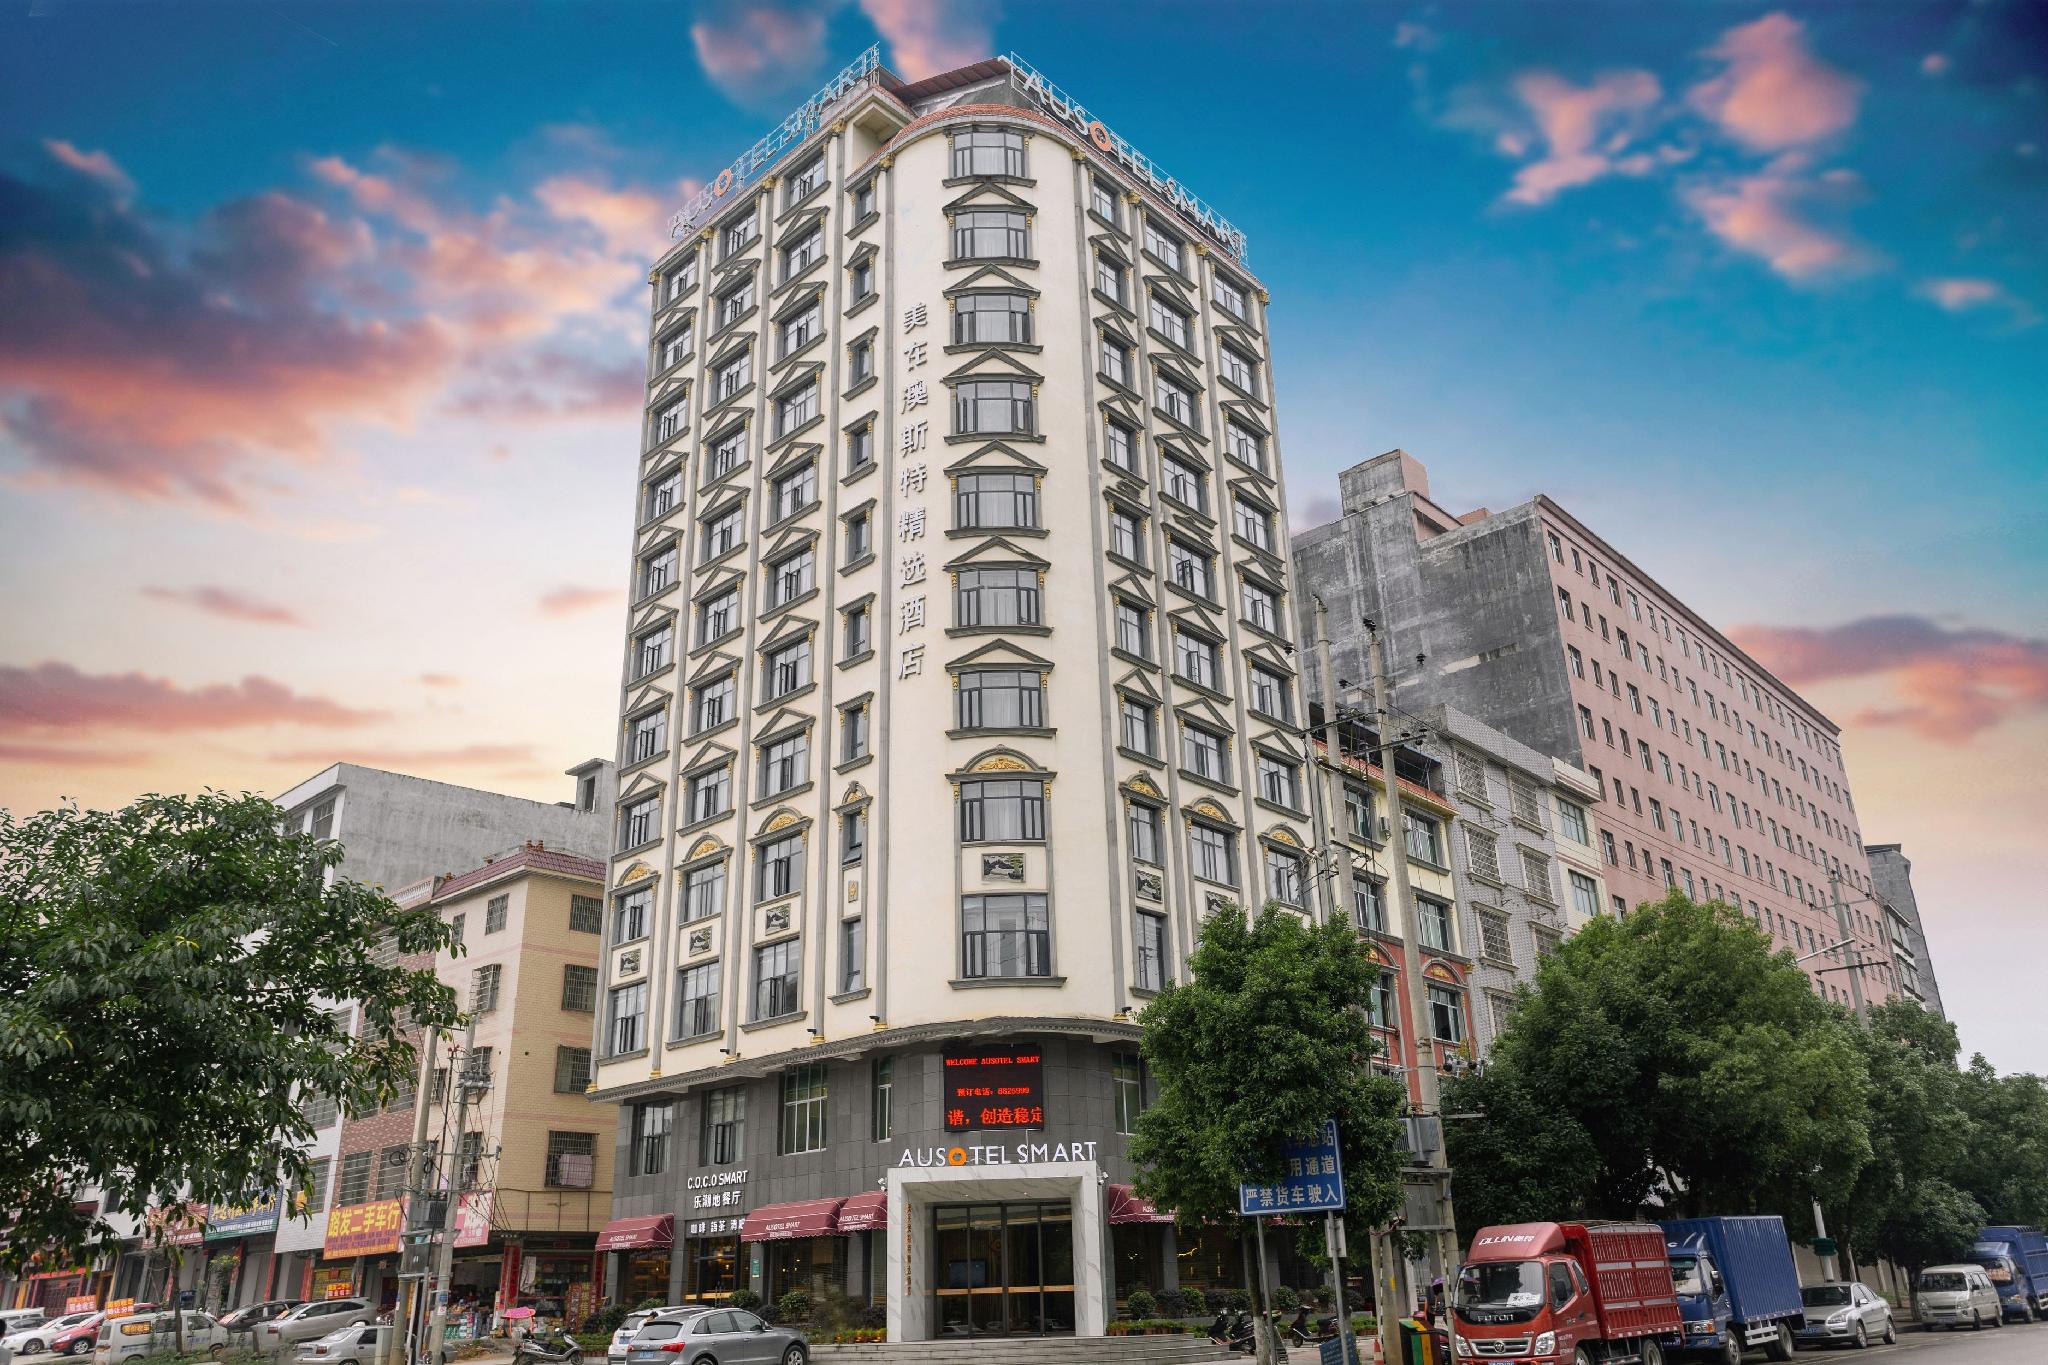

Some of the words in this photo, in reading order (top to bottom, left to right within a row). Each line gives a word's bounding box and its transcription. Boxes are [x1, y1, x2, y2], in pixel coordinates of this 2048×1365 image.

[1022, 70, 1162, 194] AUSOTEL
[1164, 176, 1247, 260] SMART
[898, 302, 928, 680] 美在澳斯特精选酒店
[946, 1058, 978, 1067] WELCOME
[980, 1057, 1013, 1066] AUSOTEL
[1016, 1056, 1040, 1064] SMART
[899, 1145, 1011, 1167] AUSOTEL
[1016, 1141, 1097, 1163] SMART
[687, 1173, 718, 1190] C.O.C.O
[718, 1169, 749, 1186] SMART
[1245, 1183, 1338, 1208] 严禁货车驶入
[327, 1201, 401, 1238] 路发二手车行
